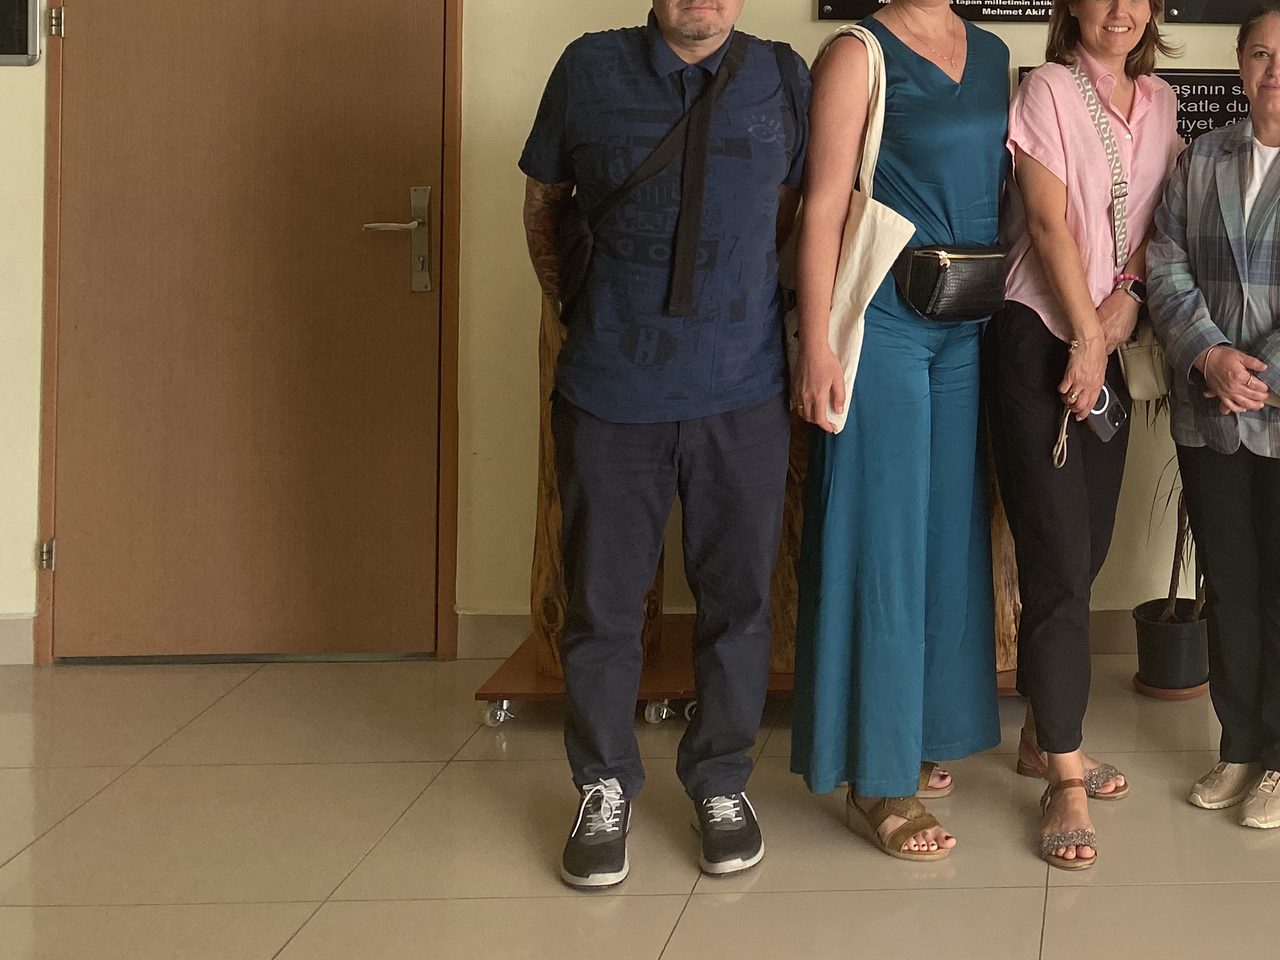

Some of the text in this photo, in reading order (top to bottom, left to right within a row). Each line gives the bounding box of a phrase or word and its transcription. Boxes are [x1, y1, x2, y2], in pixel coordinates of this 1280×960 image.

[982, 7, 1022, 15] Mehmet
[1025, 7, 1045, 16] Akif
[1178, 100, 1220, 112] katle
